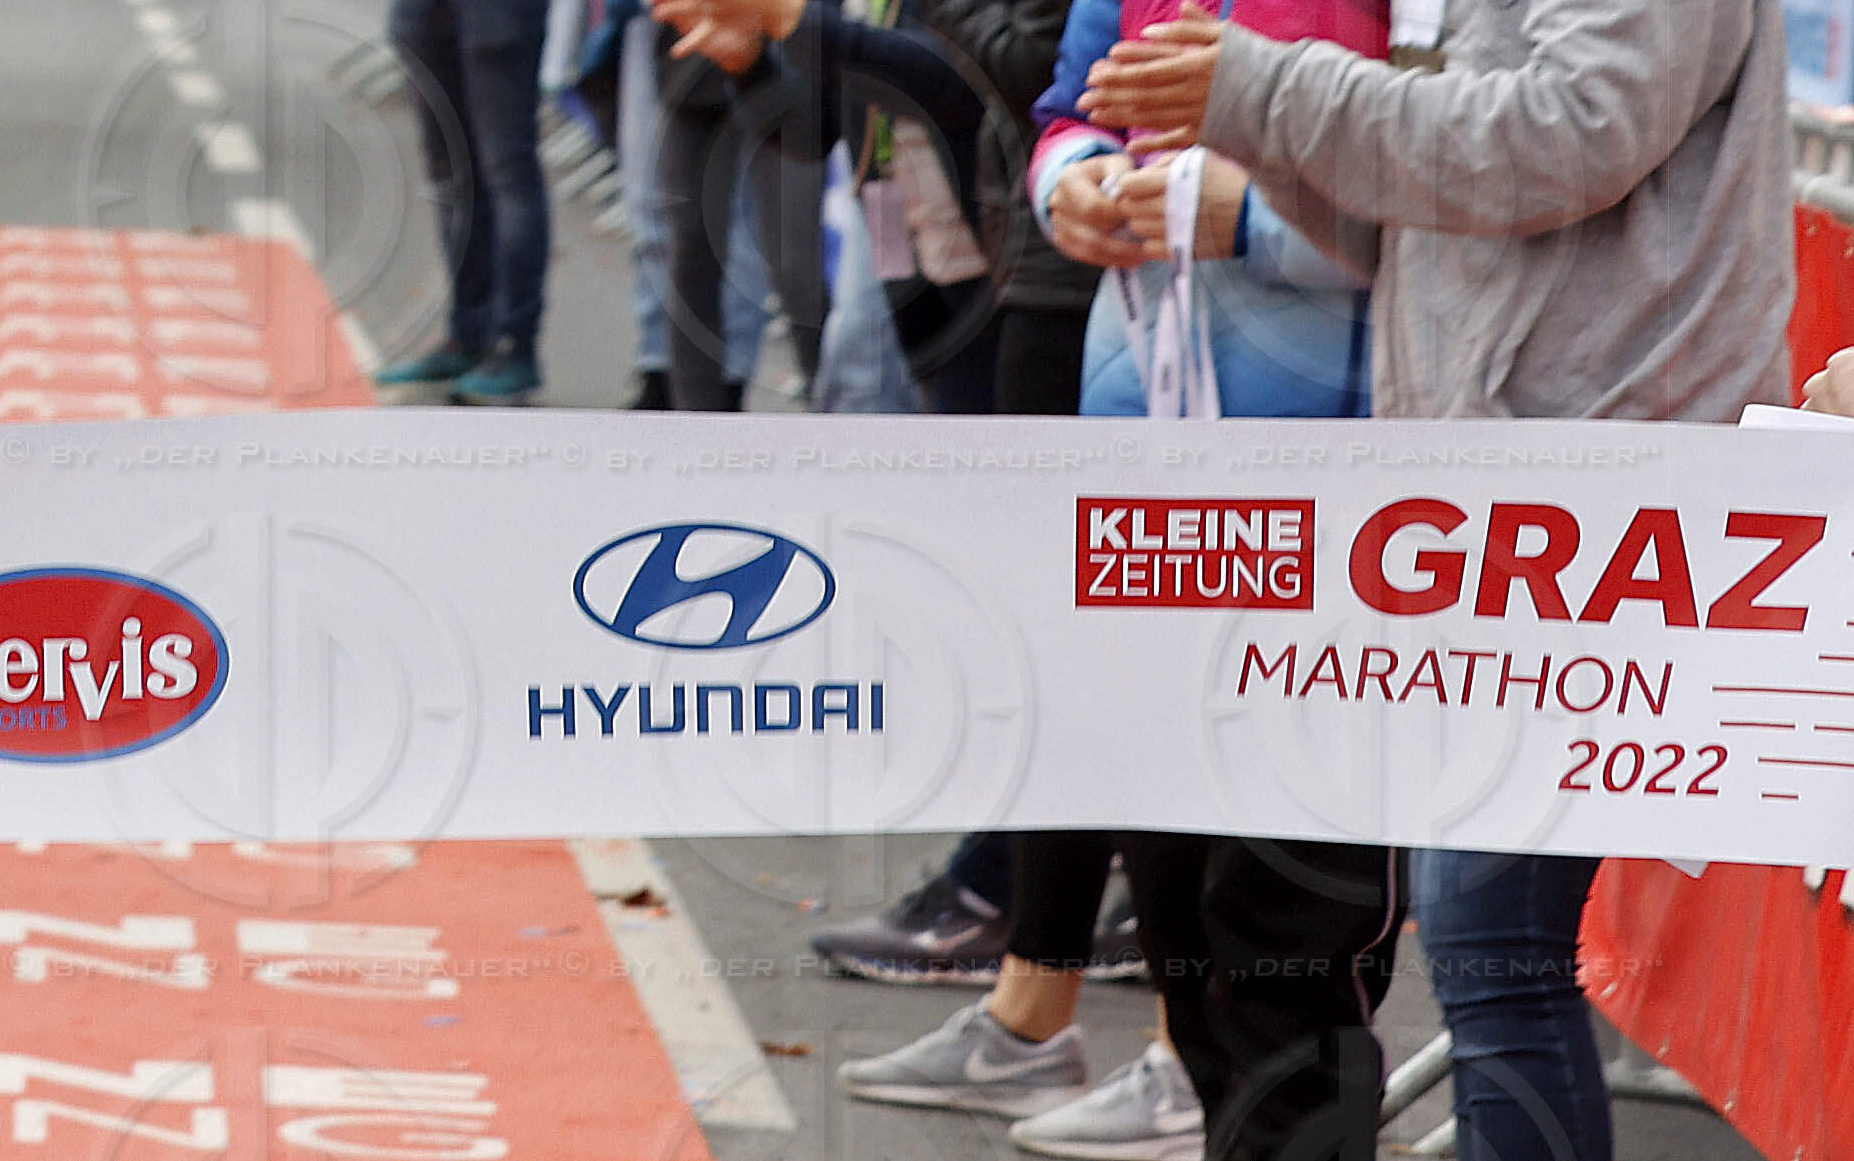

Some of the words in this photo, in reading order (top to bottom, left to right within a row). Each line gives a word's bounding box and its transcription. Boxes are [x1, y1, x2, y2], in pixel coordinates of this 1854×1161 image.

[1088, 507, 1303, 552] KLEINE
[1087, 552, 1302, 599] ZEITUNG
[1348, 497, 1828, 631] GRAZ
[1237, 641, 1675, 716] MARATHON
[528, 685, 883, 736] HYUNDAI
[1558, 740, 1729, 797] 2022
